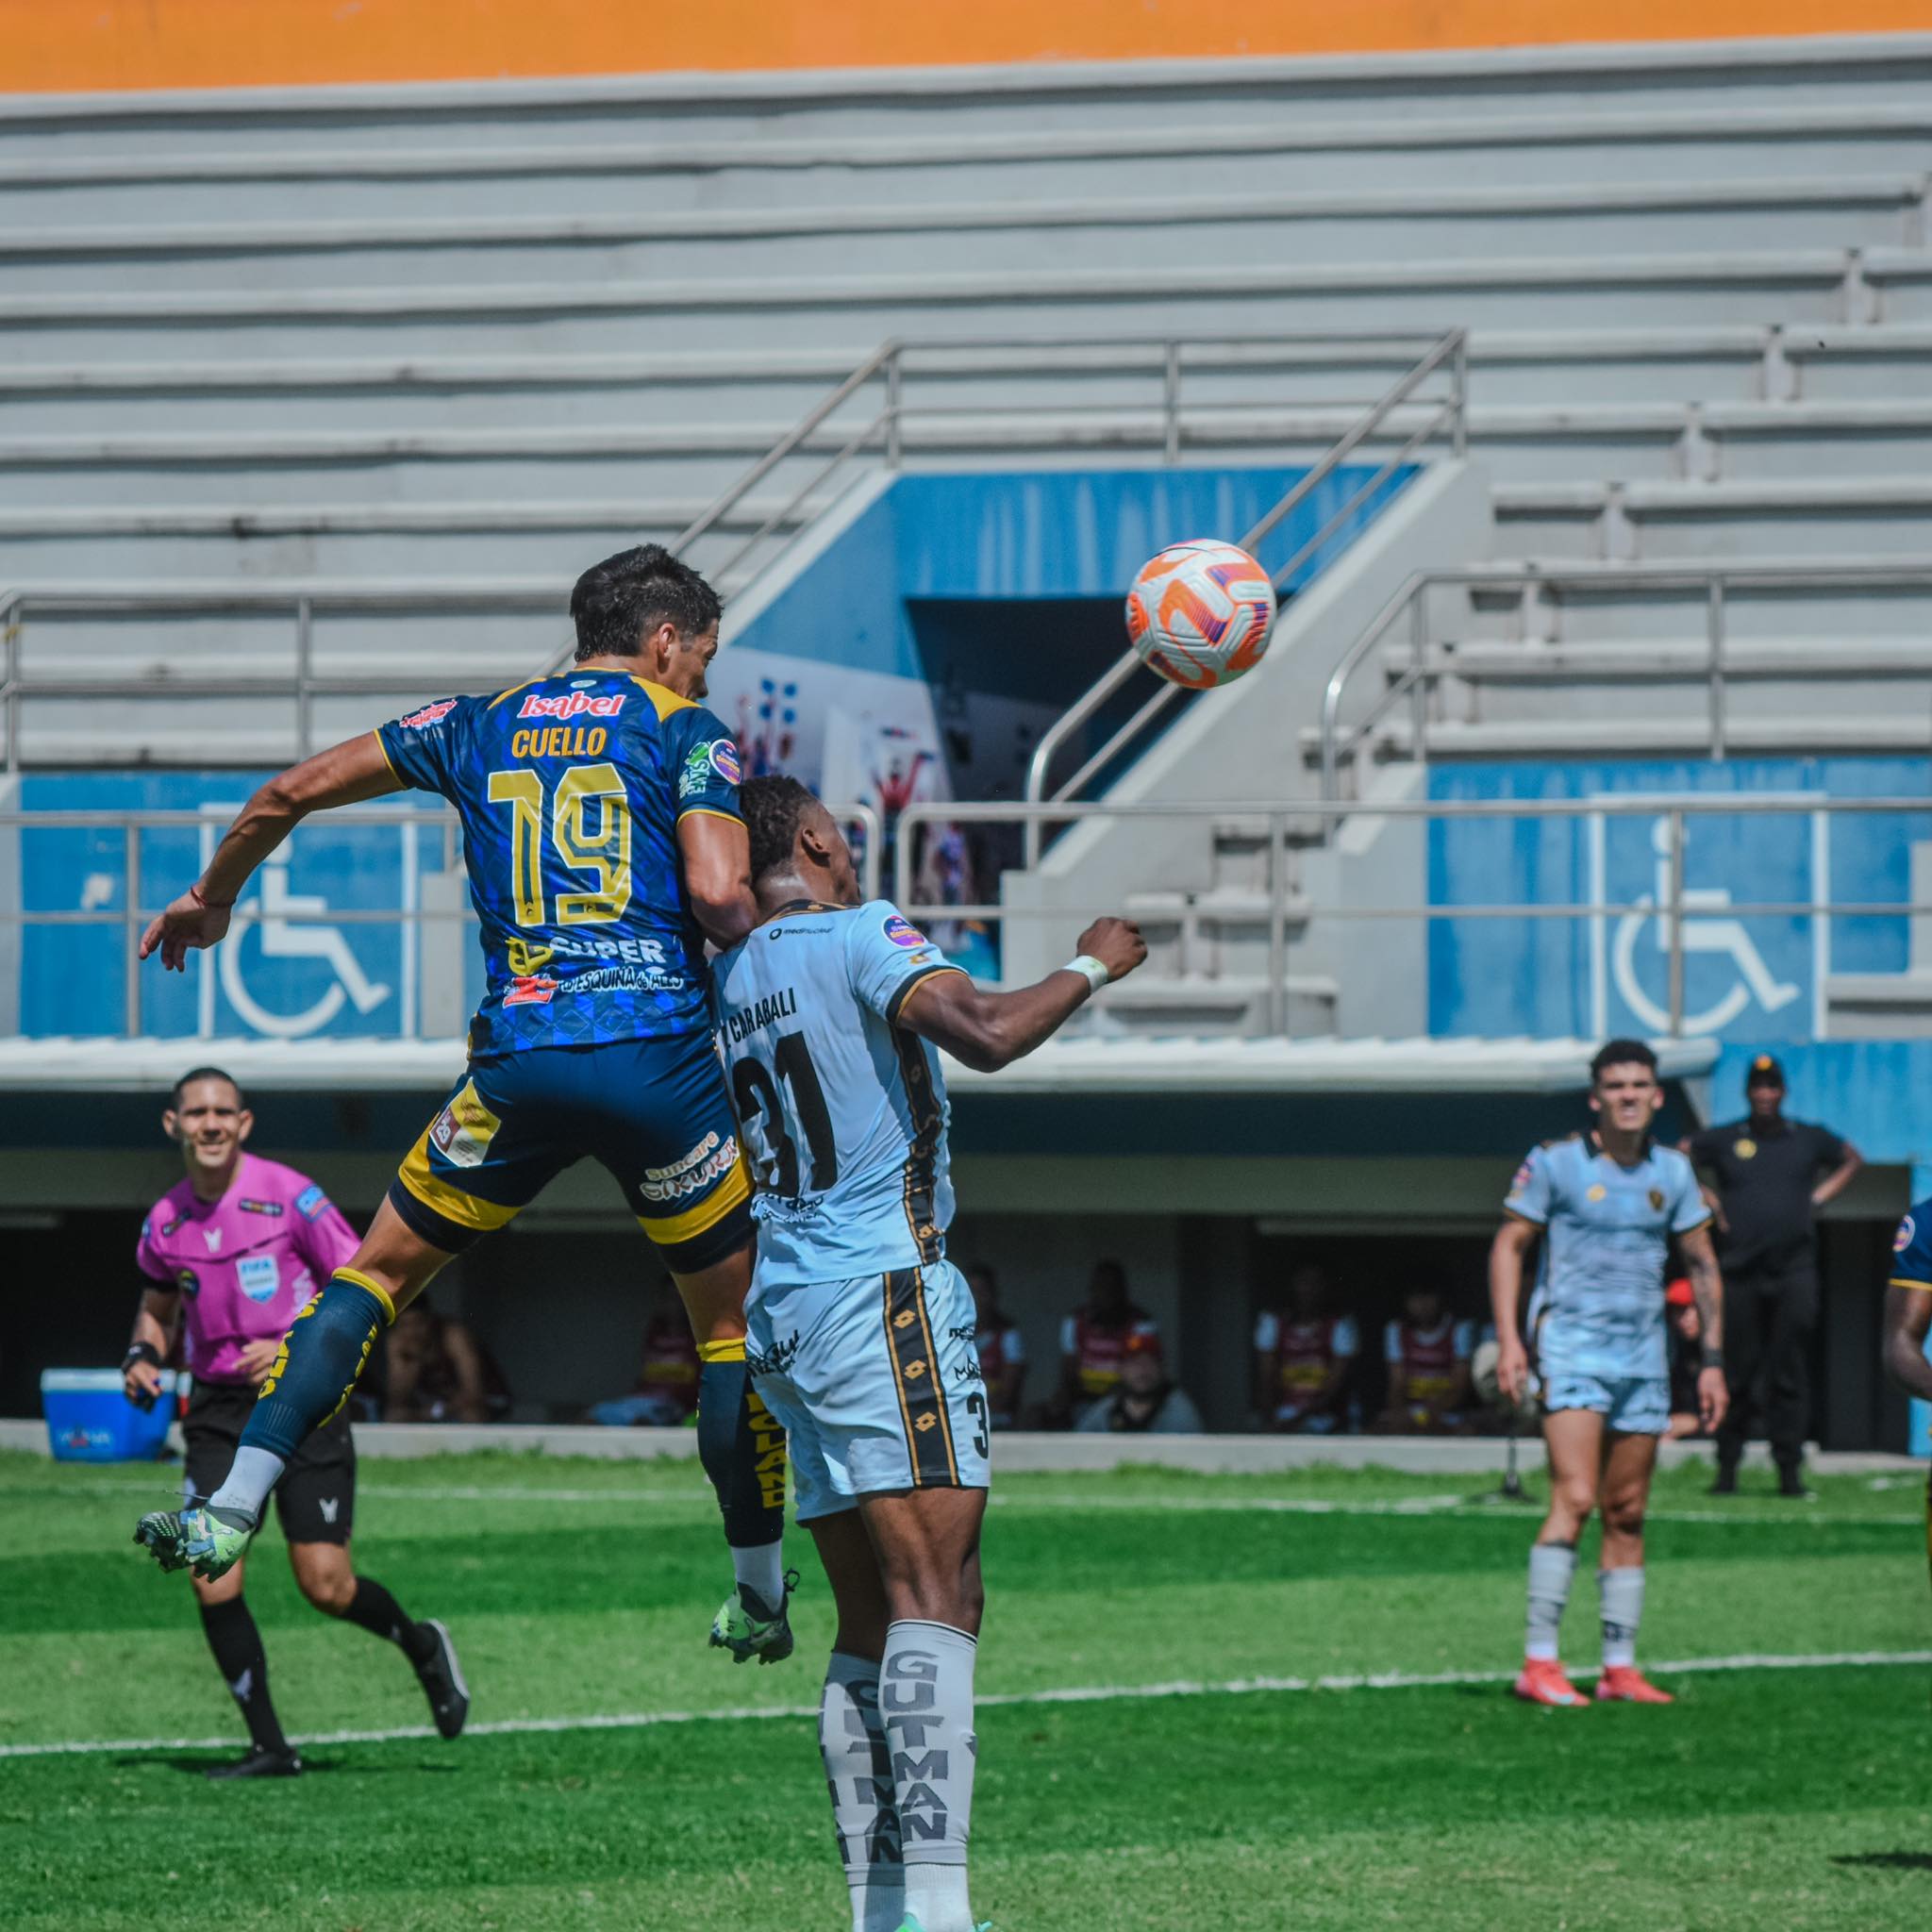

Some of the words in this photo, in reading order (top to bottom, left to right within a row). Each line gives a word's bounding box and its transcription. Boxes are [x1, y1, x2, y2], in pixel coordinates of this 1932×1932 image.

[517, 691, 626, 720] Isabel
[511, 727, 608, 758] CUELLO
[488, 763, 632, 927] 19
[549, 937, 667, 963] SUPER
[575, 966, 635, 992] ESQUINA
[728, 987, 797, 1043] CARABALI
[732, 1030, 838, 1197] 31
[883, 1650, 949, 1841] GUTMAN
